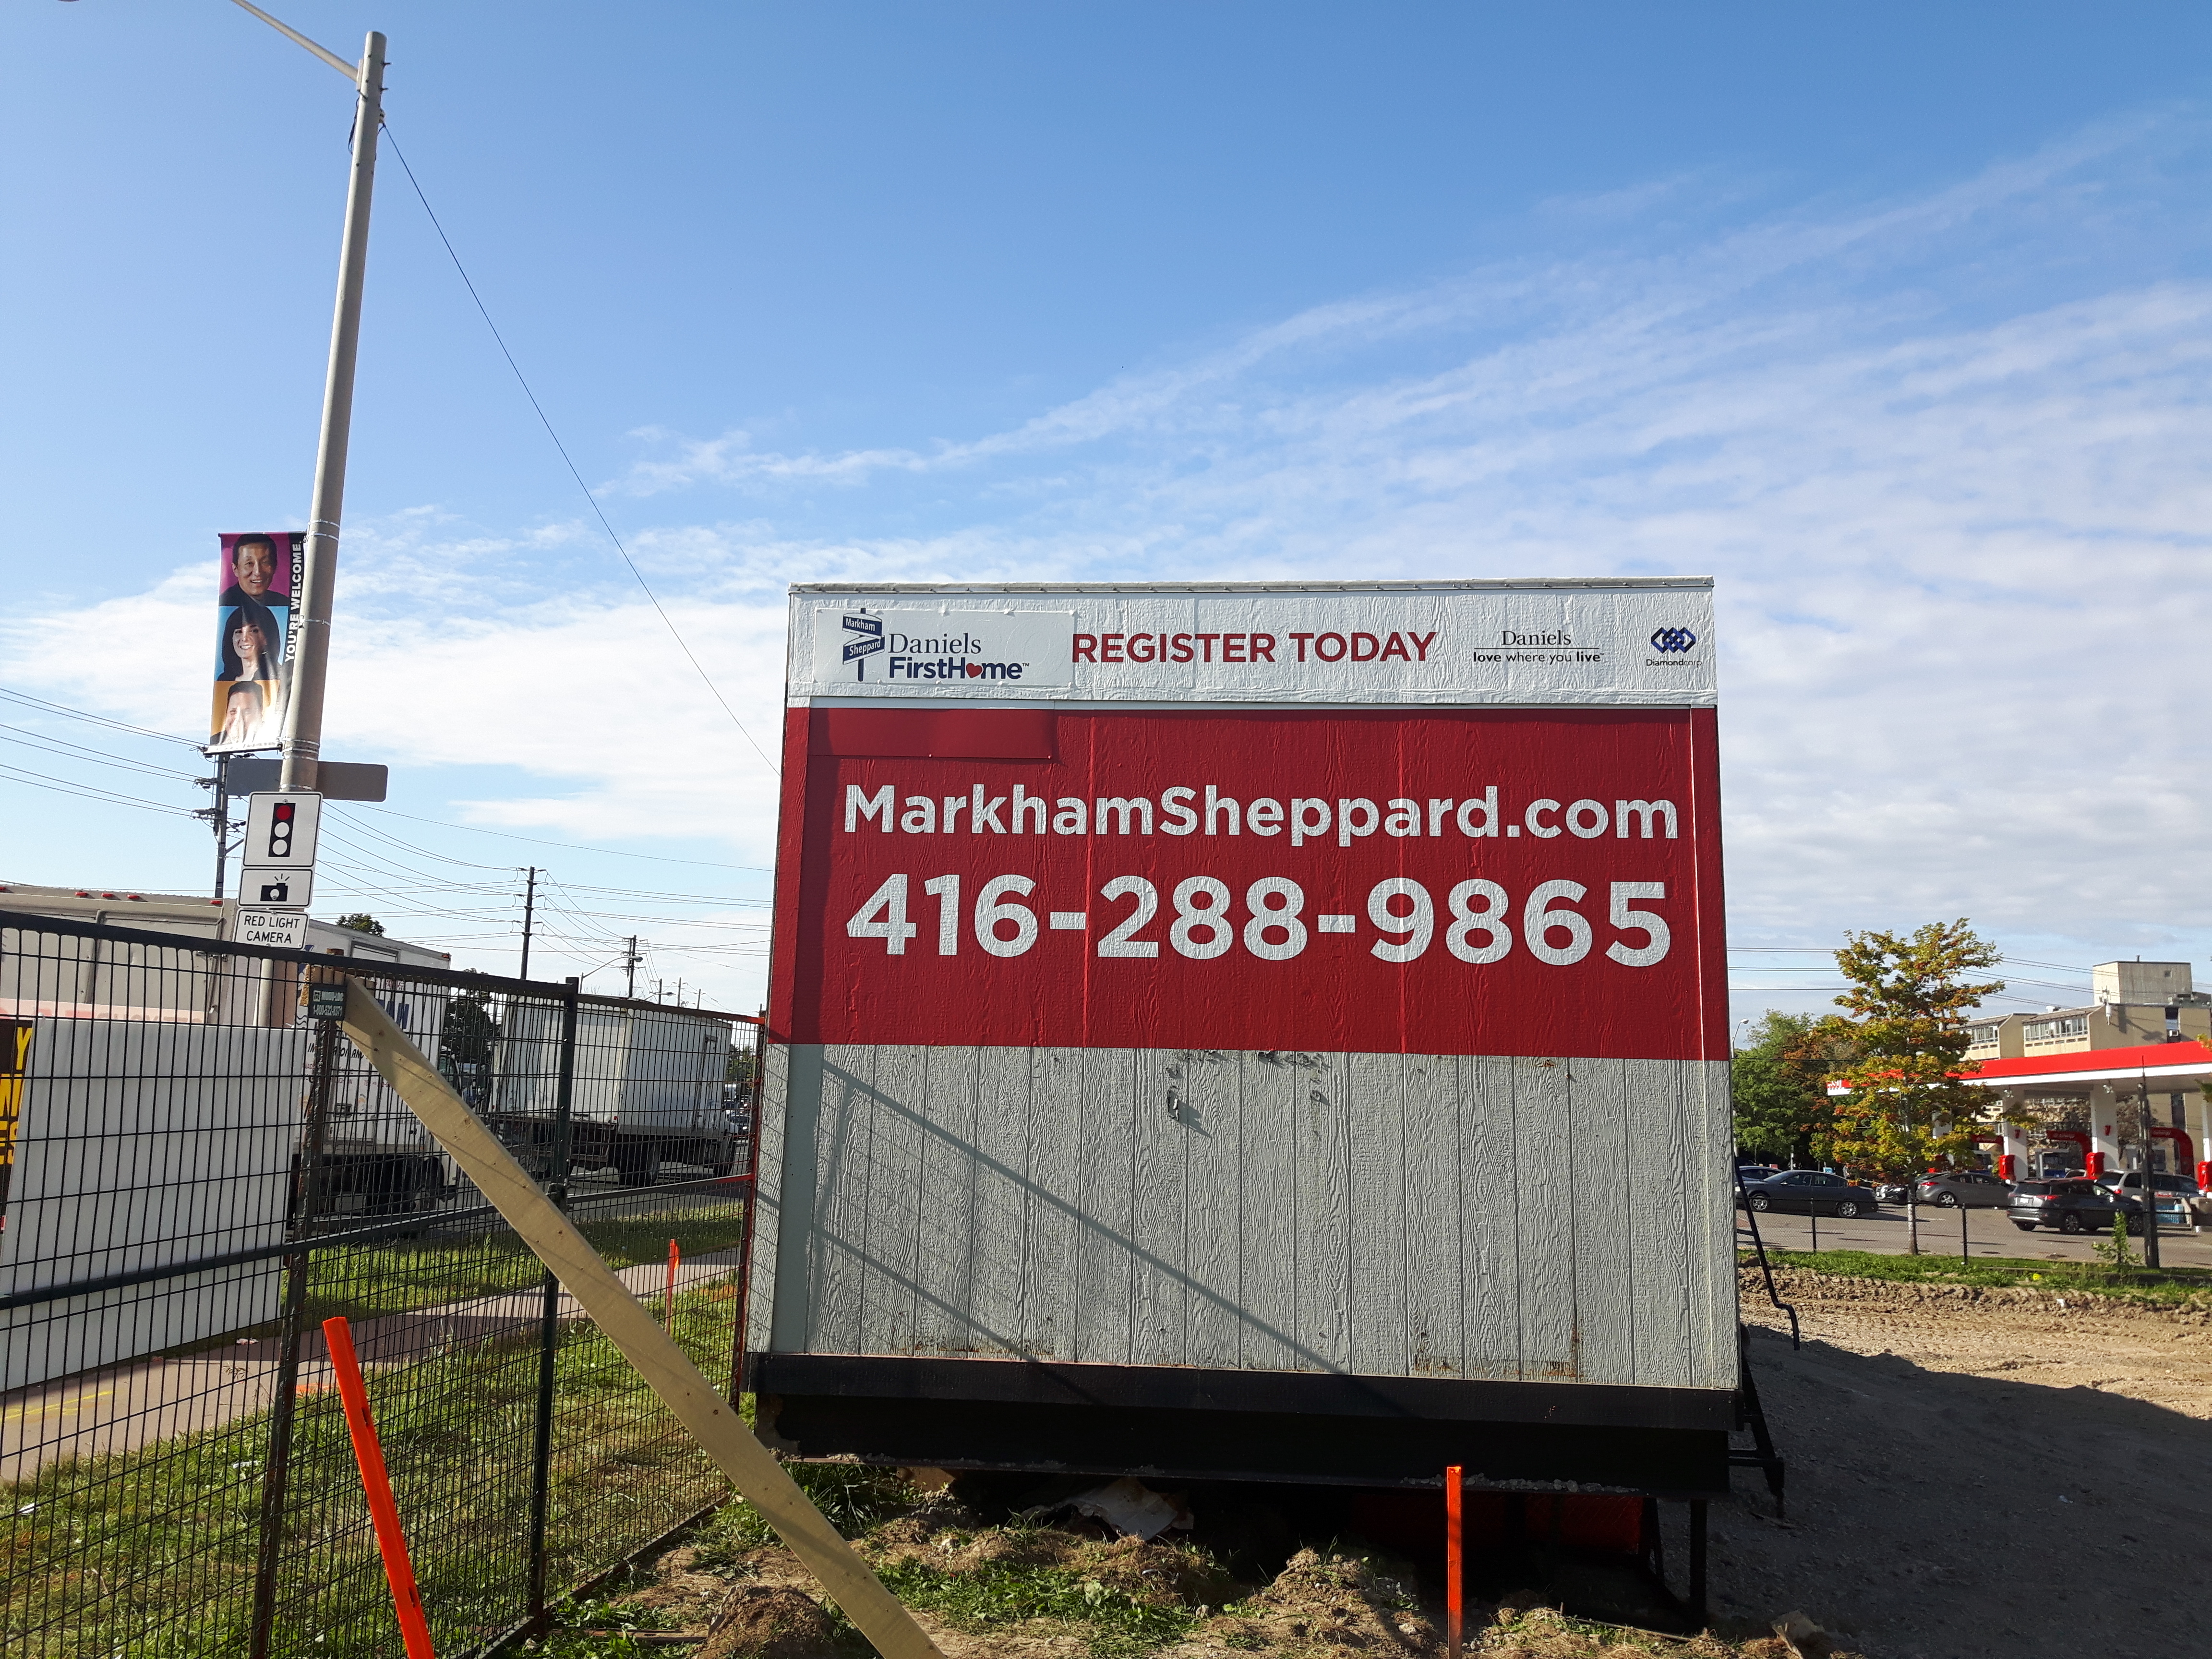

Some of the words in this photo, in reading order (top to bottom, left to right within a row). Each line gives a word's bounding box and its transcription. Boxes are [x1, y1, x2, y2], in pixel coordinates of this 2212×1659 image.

[845, 618, 876, 632] Markham
[285, 614, 299, 662] YOU'RE
[888, 633, 982, 654] Daniels
[1502, 630, 1572, 646] Daniels
[848, 639, 881, 657] Sheppard
[1071, 633, 1276, 663] REGISTER
[1288, 632, 1436, 662] TODAY
[1473, 652, 1502, 662] love
[1505, 652, 1545, 662] where
[1549, 654, 1572, 665] you
[1576, 651, 1600, 662] live
[1646, 659, 1702, 668] Diamondcorp
[844, 784, 1678, 847] MarkhamSheppard.com
[244, 915, 265, 926] RED
[269, 916, 300, 928] LIGHT
[846, 874, 1671, 967] 416-288-9865
[246, 930, 292, 944] CAMERA
